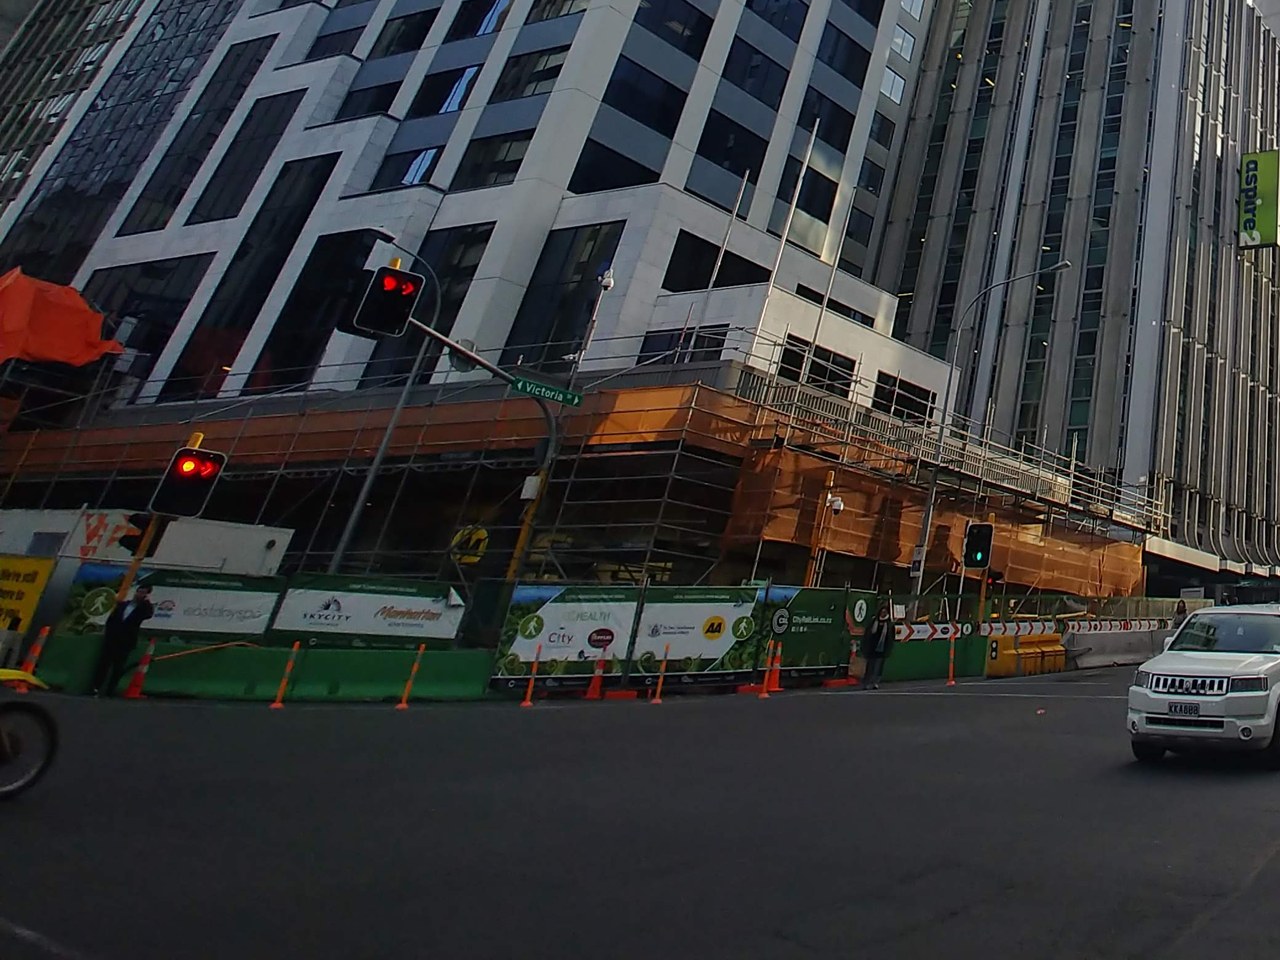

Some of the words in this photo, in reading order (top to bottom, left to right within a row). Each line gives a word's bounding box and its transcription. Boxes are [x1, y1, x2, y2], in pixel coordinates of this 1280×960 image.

[526, 382, 564, 402] Victoria
[303, 613, 352, 621] SKYCITY
[373, 605, 442, 623] Manhattan
[705, 622, 723, 634] AA
[548, 632, 574, 644] City
